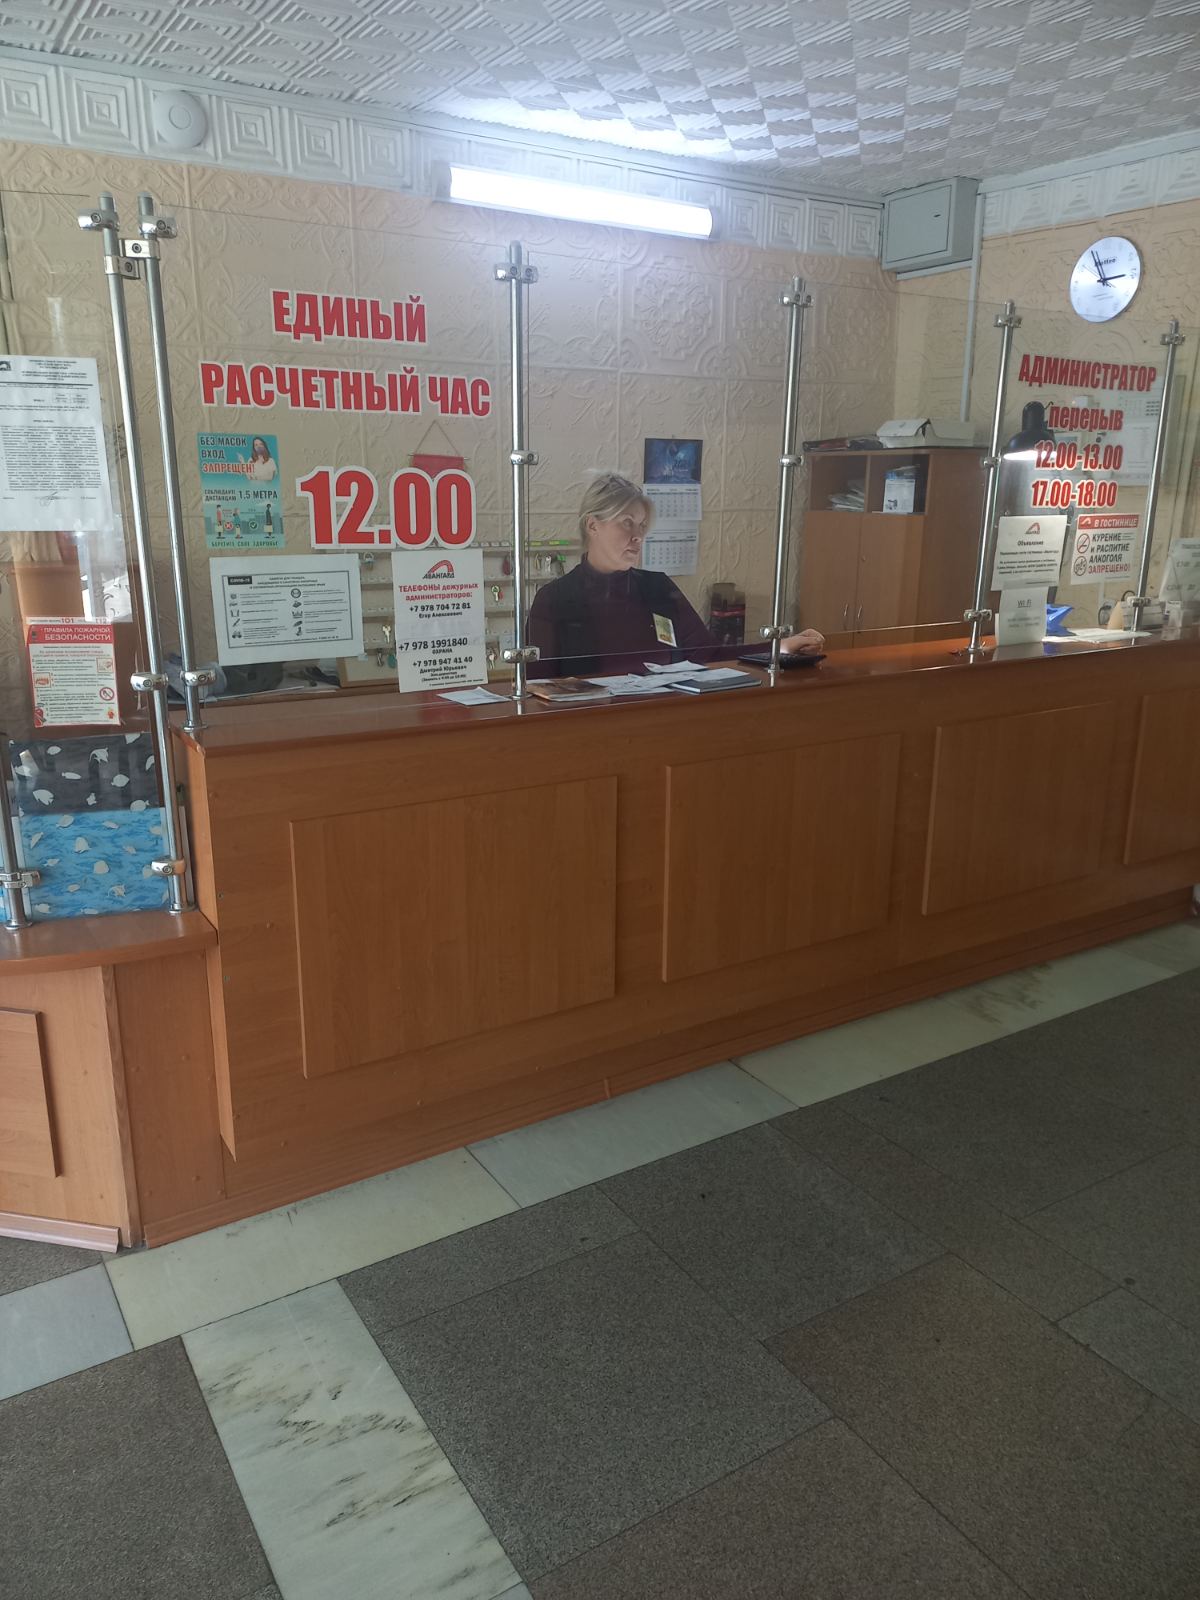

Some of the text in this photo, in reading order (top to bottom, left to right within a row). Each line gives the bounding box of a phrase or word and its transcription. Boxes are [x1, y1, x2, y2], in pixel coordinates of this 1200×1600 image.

[272, 290, 427, 343] ЕДИНЫЙ
[1018, 354, 1157, 392] АДМИНИСТРАТОР
[200, 363, 491, 417] РАСЧЕТНЫЙ ЧАС
[1048, 405, 1124, 432] перерыв
[200, 436, 247, 447] БЕЗ МАСОК
[201, 449, 225, 459] ВХОД
[1035, 442, 1124, 470] 12.00-13.00
[203, 463, 255, 474] ЗАПРЕЩЕН!
[253, 491, 278, 500] МЕТРА
[1032, 481, 1118, 507] 17.00-18.00
[300, 470, 473, 545] 12.00
[1094, 518, 1138, 527] В ГОСТИНИЦЕ
[1092, 533, 1122, 542] КУРЕНИЕ
[1096, 543, 1130, 553] РАСПИТИЕ
[1089, 554, 1122, 564] АЛКОГОЛЯ
[1088, 564, 1131, 574] ЗАПРЕЩЕНО!
[399, 583, 479, 592] ТЕЛЕФОНЫ дежурных
[405, 592, 473, 601] администраторов:
[399, 637, 468, 651] +7 978 1991840
